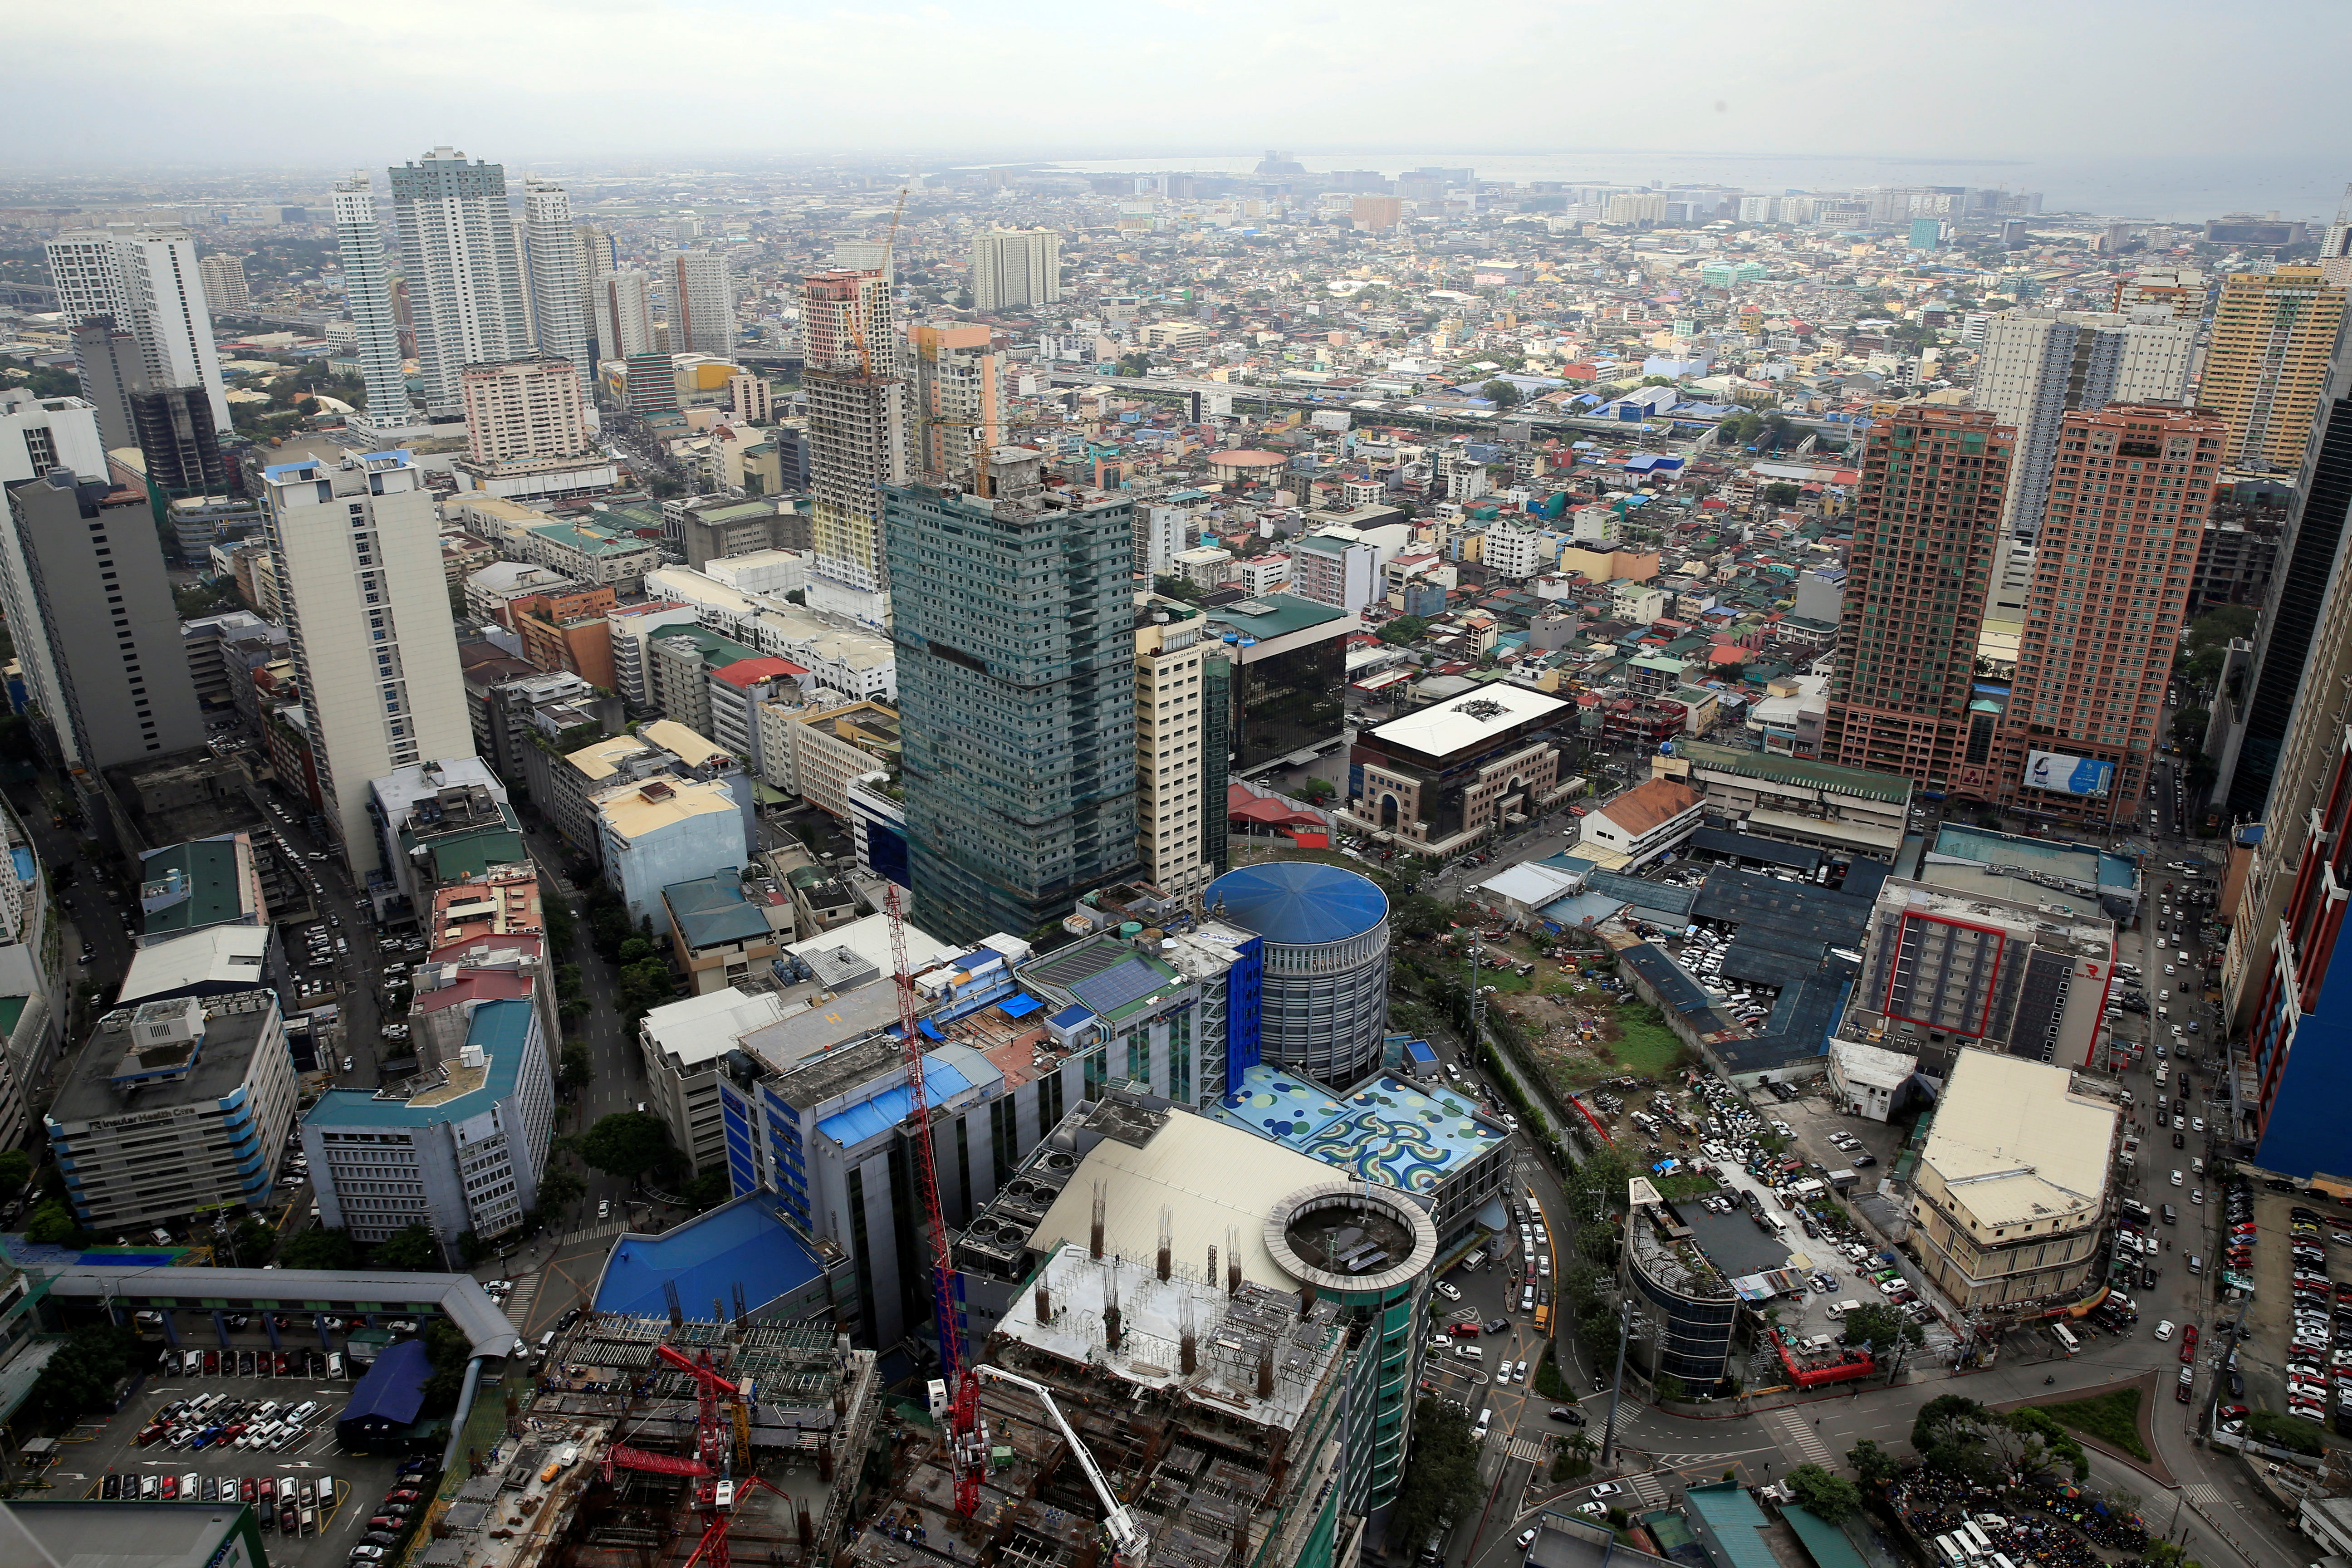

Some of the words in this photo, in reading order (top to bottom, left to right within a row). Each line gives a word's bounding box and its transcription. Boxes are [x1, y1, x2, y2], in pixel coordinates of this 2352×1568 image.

[1186, 649, 1201, 657] MAKATI
[824, 1012, 843, 1024] H
[102, 1116, 137, 1128] Insular
[138, 1110, 172, 1122] Health
[173, 1107, 196, 1117] Care
